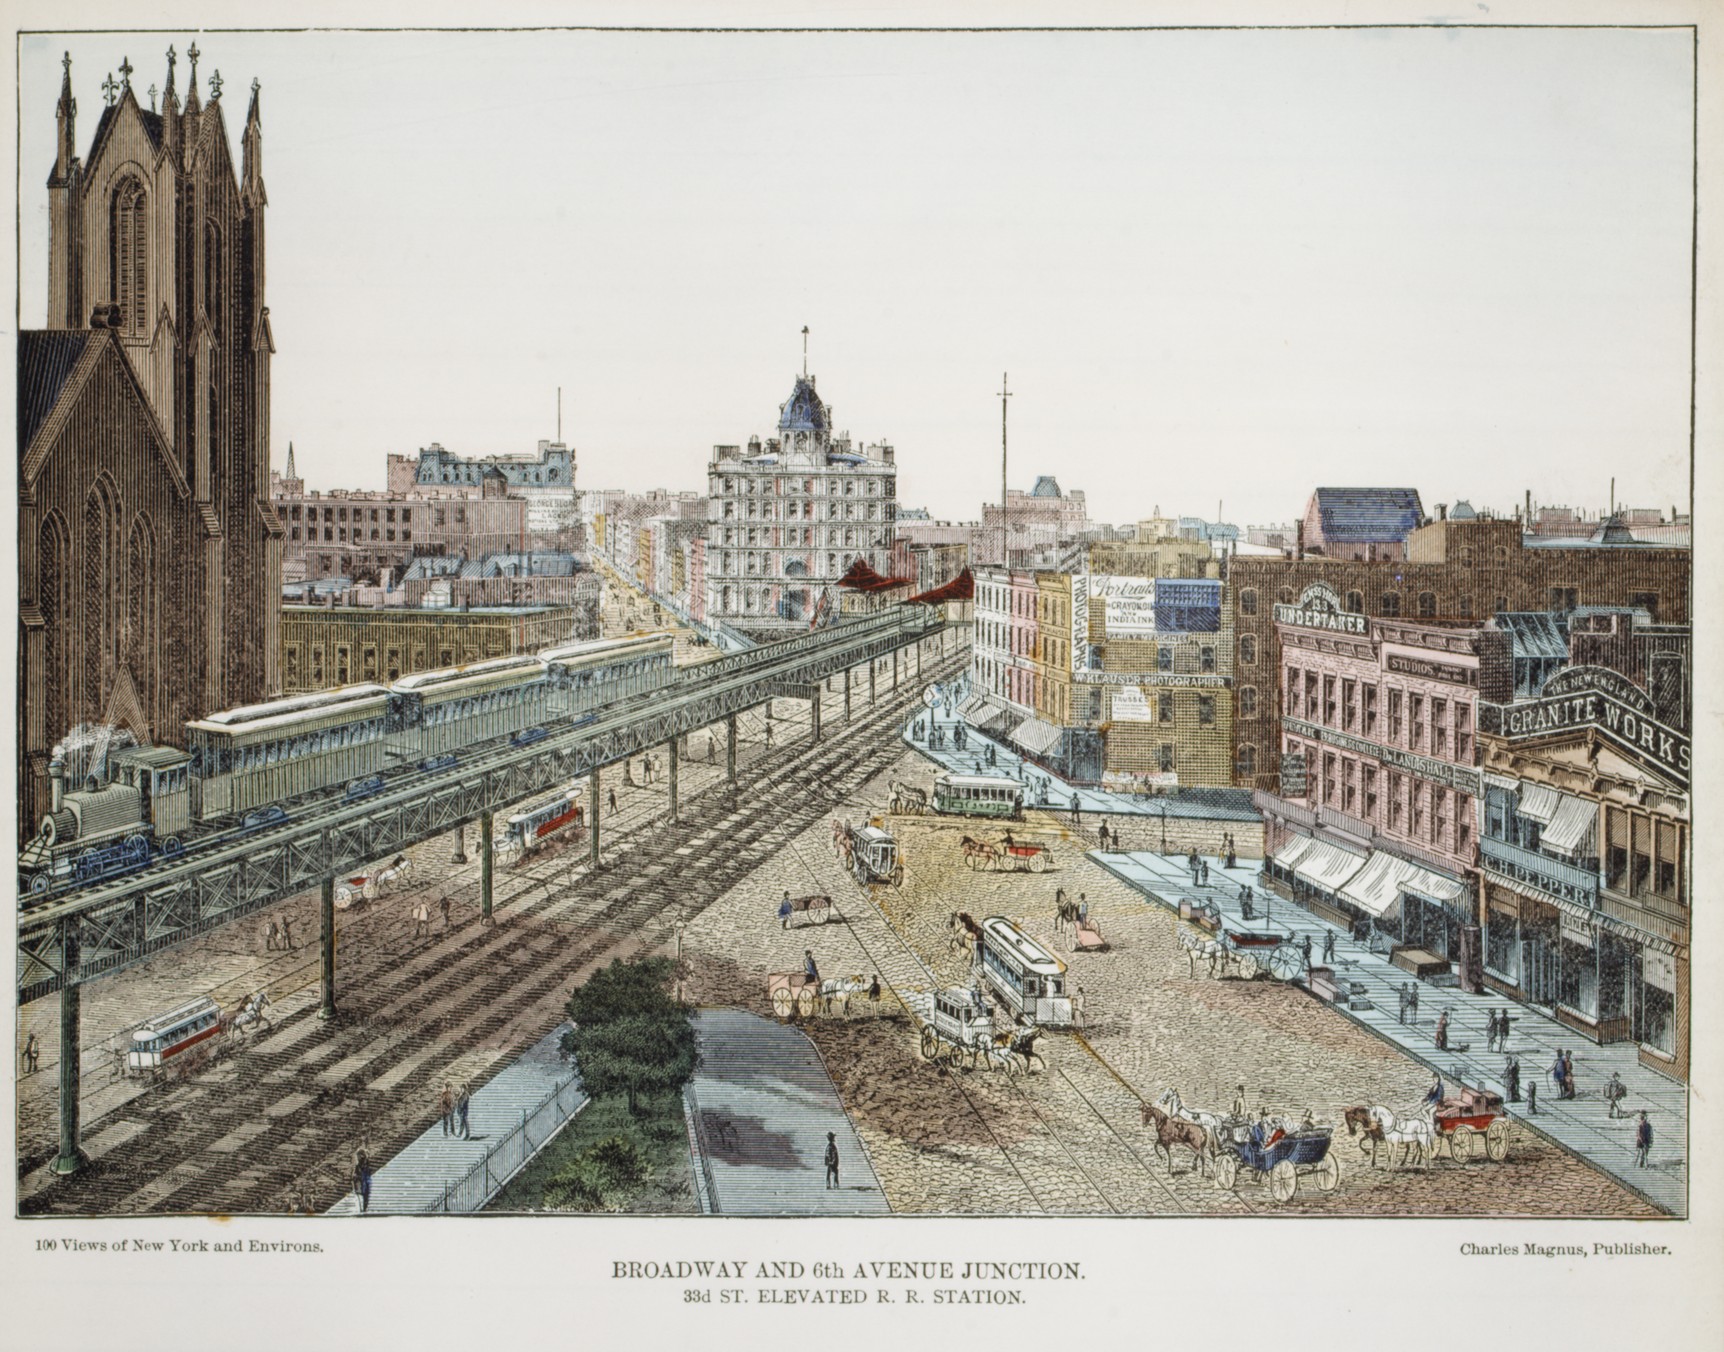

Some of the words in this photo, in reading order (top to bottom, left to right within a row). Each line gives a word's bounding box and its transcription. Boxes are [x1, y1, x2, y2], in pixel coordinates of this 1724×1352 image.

[1093, 576, 1155, 597] Portraits
[1073, 577, 1088, 671] PHOTOGRAPHS
[1137, 616, 1154, 624] INK
[1279, 607, 1366, 633] UNDERTAKER
[1086, 674, 1141, 685] KLAUSER
[1144, 676, 1225, 688] PHOTOGRAPHER
[1550, 682, 1569, 695] THE
[1570, 674, 1593, 688] NEW
[1593, 674, 1645, 711] ENGLAND
[1509, 696, 1596, 733] GRANITE
[1604, 702, 1691, 771] WORKS
[36, 1239, 57, 1251] 100
[61, 1239, 107, 1251] Views
[112, 1239, 128, 1251] of
[133, 1239, 164, 1252] New
[169, 1239, 208, 1252] York
[214, 1239, 243, 1252] and
[249, 1240, 324, 1253] Environs.
[1460, 1243, 1519, 1255] Charles
[1524, 1243, 1588, 1258] Magnus,
[1593, 1243, 1672, 1255] Publisher.
[612, 1261, 748, 1279] BROADWAY
[756, 1261, 805, 1279] AND
[813, 1262, 844, 1279] 6th
[854, 1262, 953, 1279] AVENUE
[961, 1262, 1086, 1279] JUNCTION.
[683, 1289, 711, 1304] 33d
[720, 1289, 748, 1304] ST.
[758, 1289, 867, 1304] ELEVATED
[878, 1289, 896, 1304] R.
[906, 1289, 925, 1304] R.
[933, 1290, 1027, 1305] STATION.
